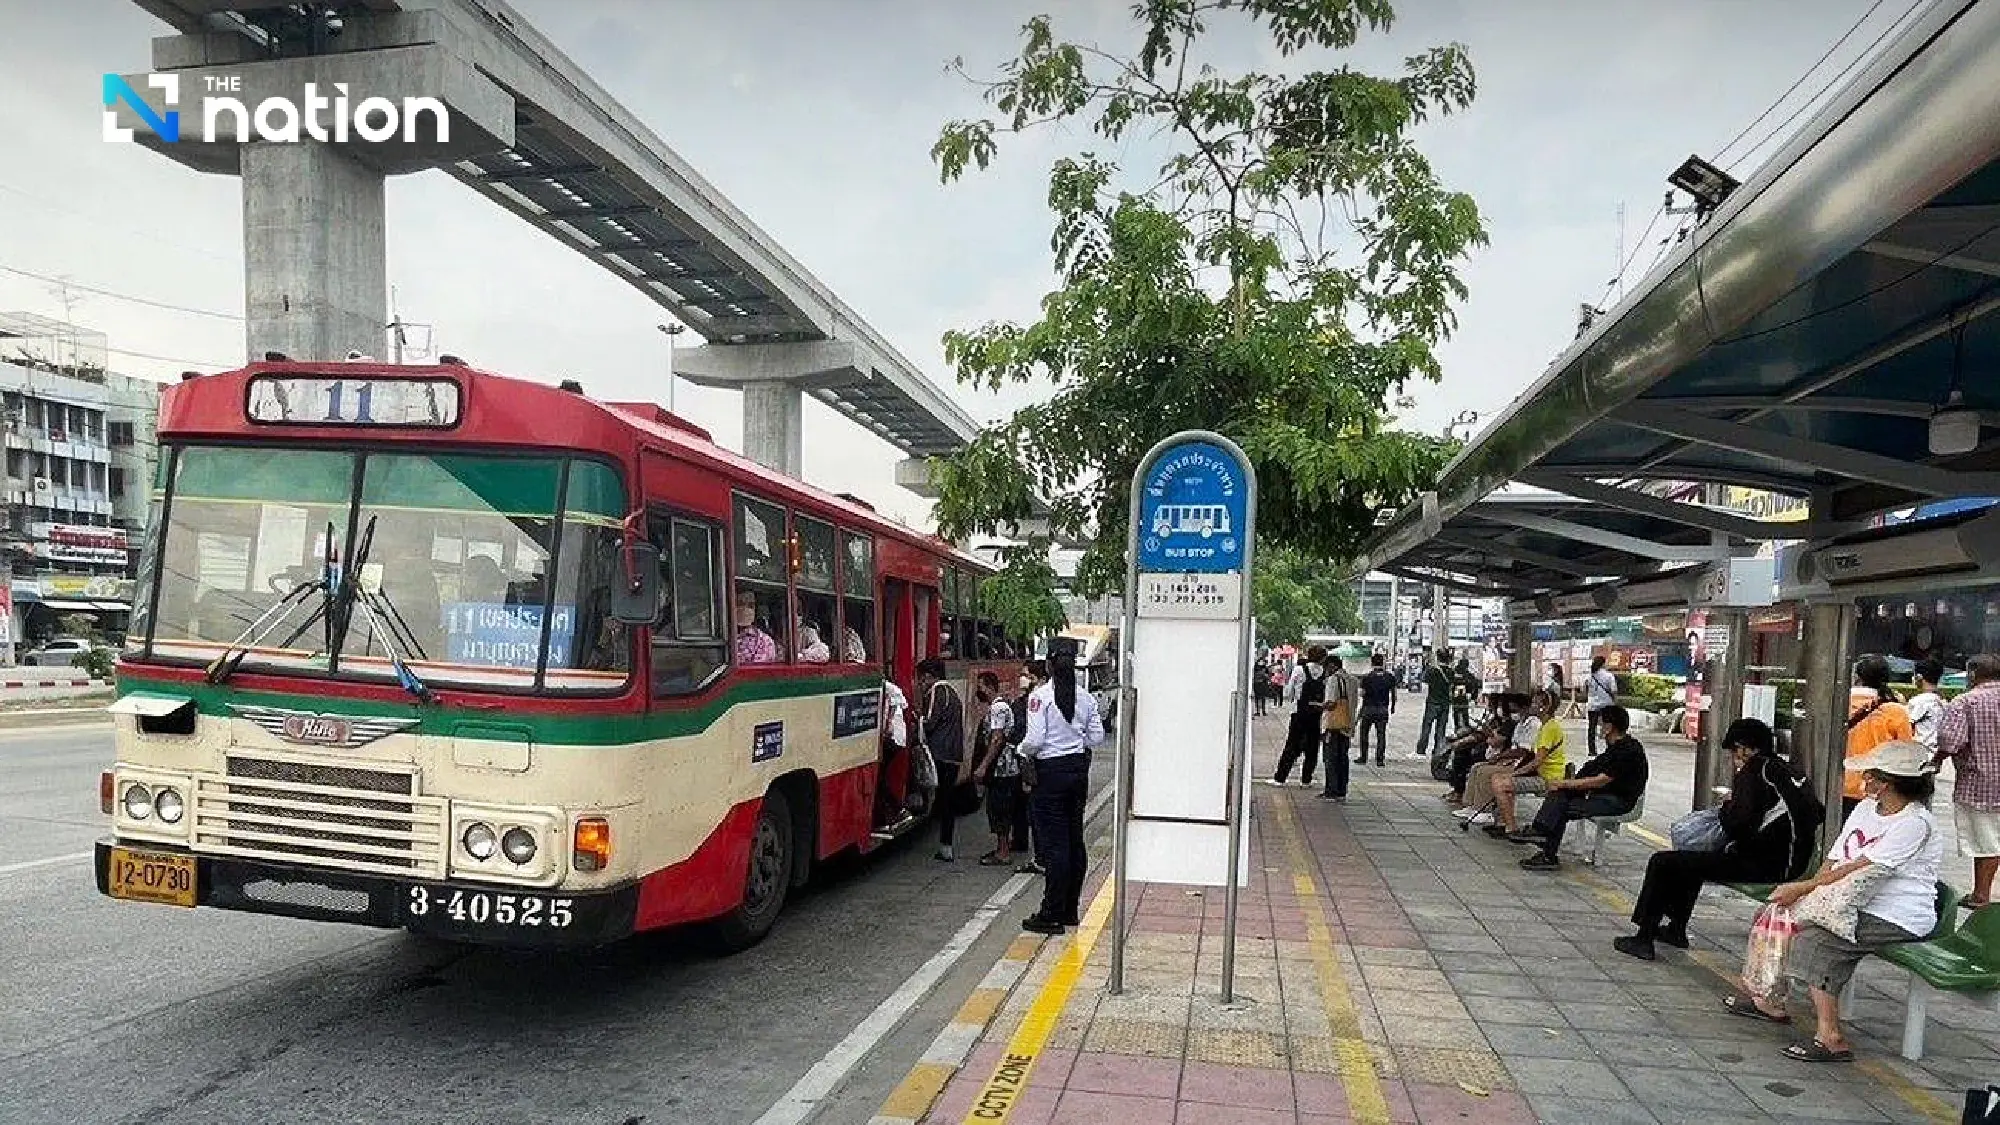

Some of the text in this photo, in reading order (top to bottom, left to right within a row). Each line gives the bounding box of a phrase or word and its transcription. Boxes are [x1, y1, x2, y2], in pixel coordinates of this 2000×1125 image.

[324, 381, 374, 422] 11
[1165, 549, 1214, 557] BUS STOP
[117, 861, 189, 891] 12-0730
[410, 886, 572, 927] 3-40525
[974, 1053, 1032, 1119] CCTV ZONE
